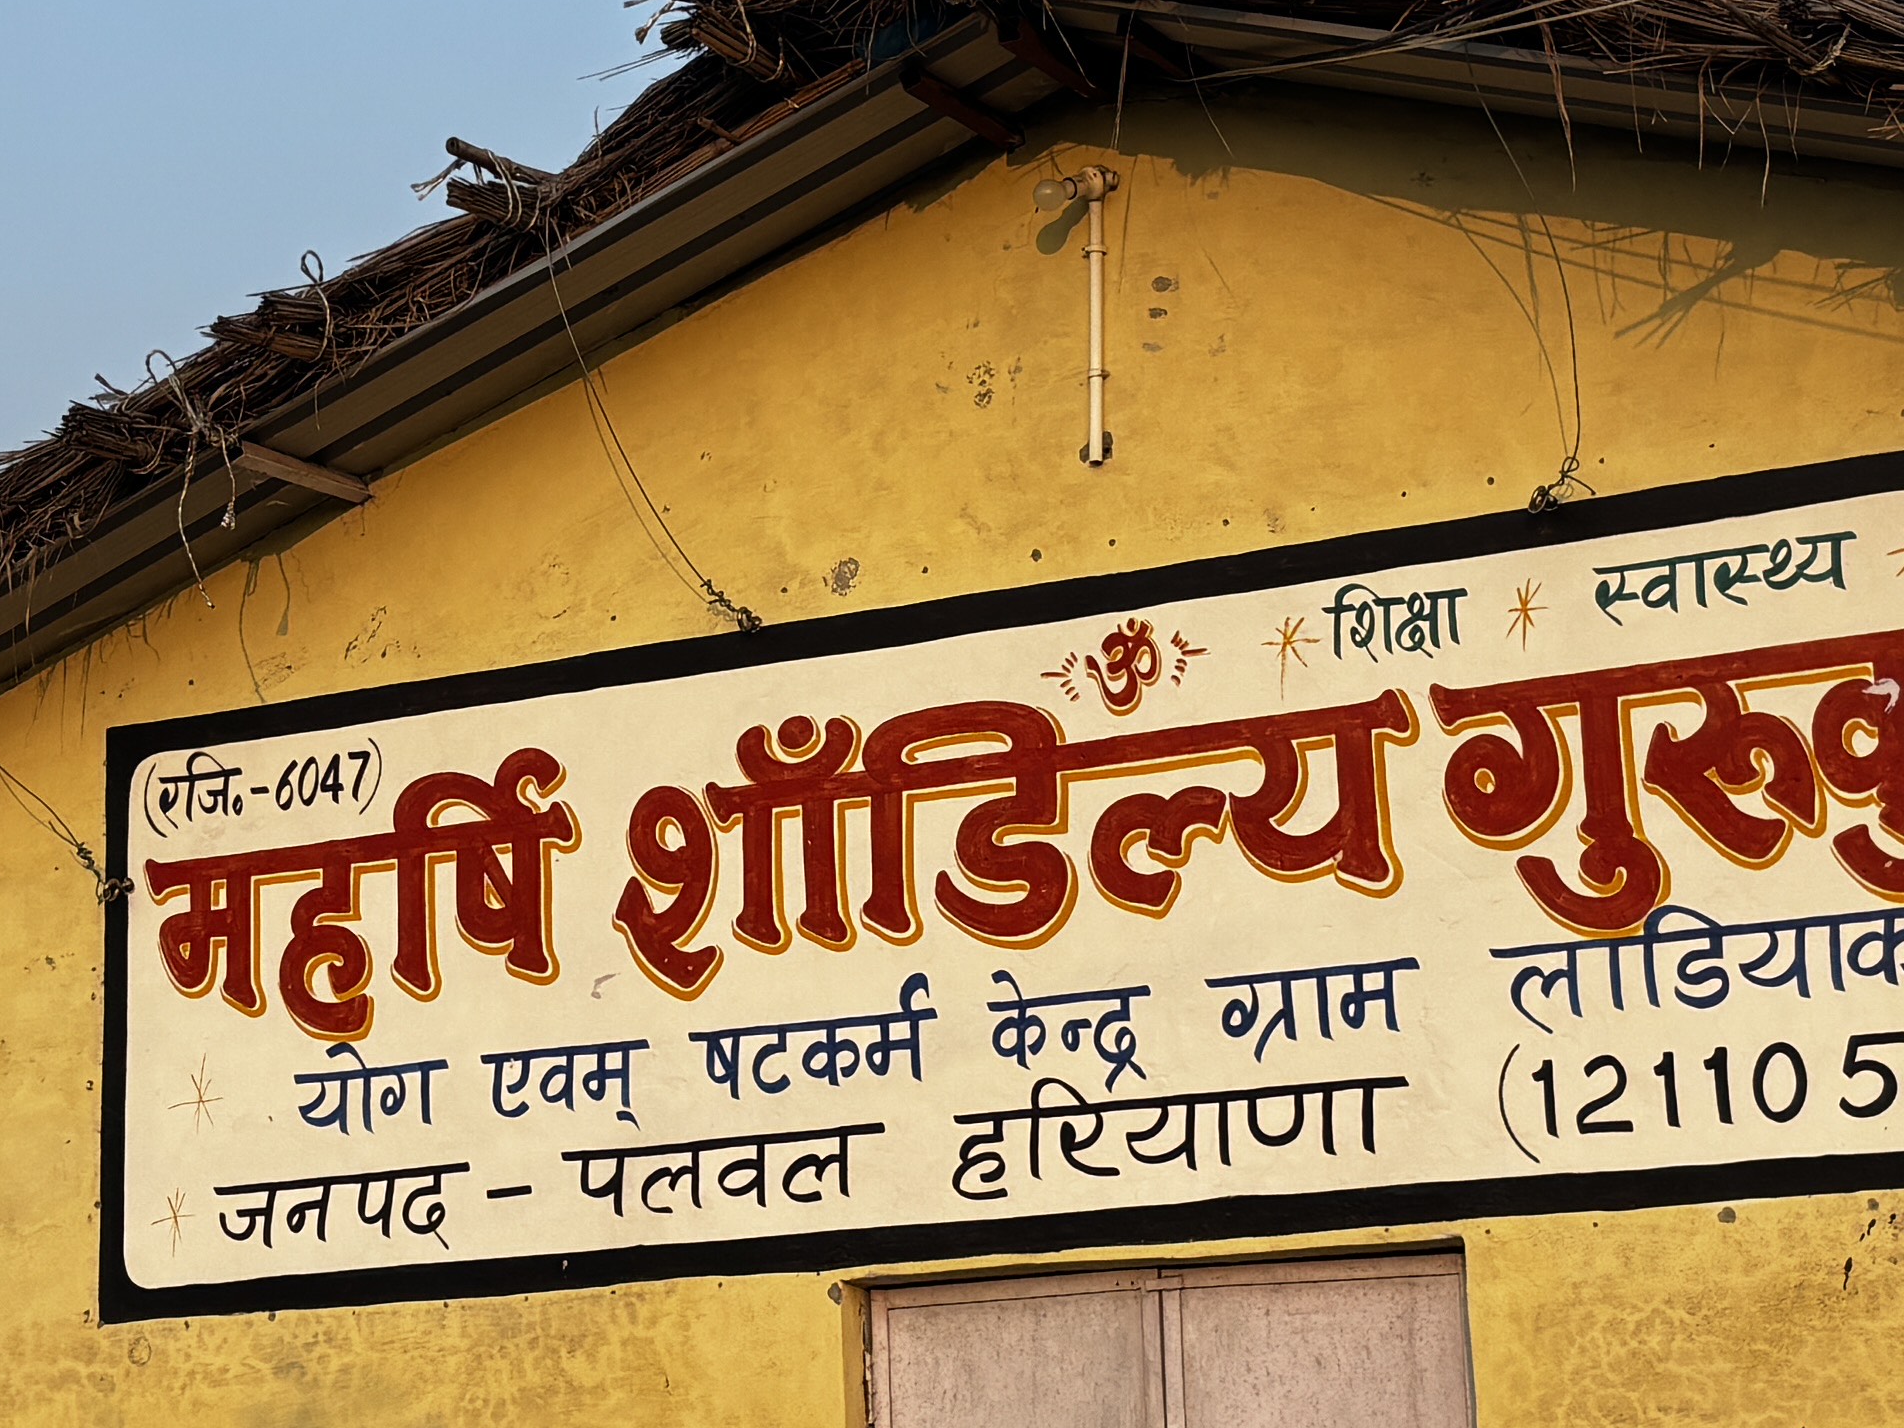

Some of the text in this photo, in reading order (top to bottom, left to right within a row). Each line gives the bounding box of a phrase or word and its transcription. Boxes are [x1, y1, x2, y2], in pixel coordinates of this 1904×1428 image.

[1322, 583, 1468, 664] शिक्षा
[1592, 530, 1858, 627] स्वास्थ्य
[143, 746, 583, 1042] महर्षि
[293, 1041, 449, 1136] योग
[480, 1038, 650, 1130] एवम्
[687, 972, 938, 1101] षटकर्म
[986, 969, 1152, 1094] केन्द्र
[1204, 956, 1421, 1064] ग्राम
[212, 1161, 471, 1250] जनपद
[560, 1121, 886, 1218] पलवल
[951, 1075, 1410, 1201] हरियाणा
